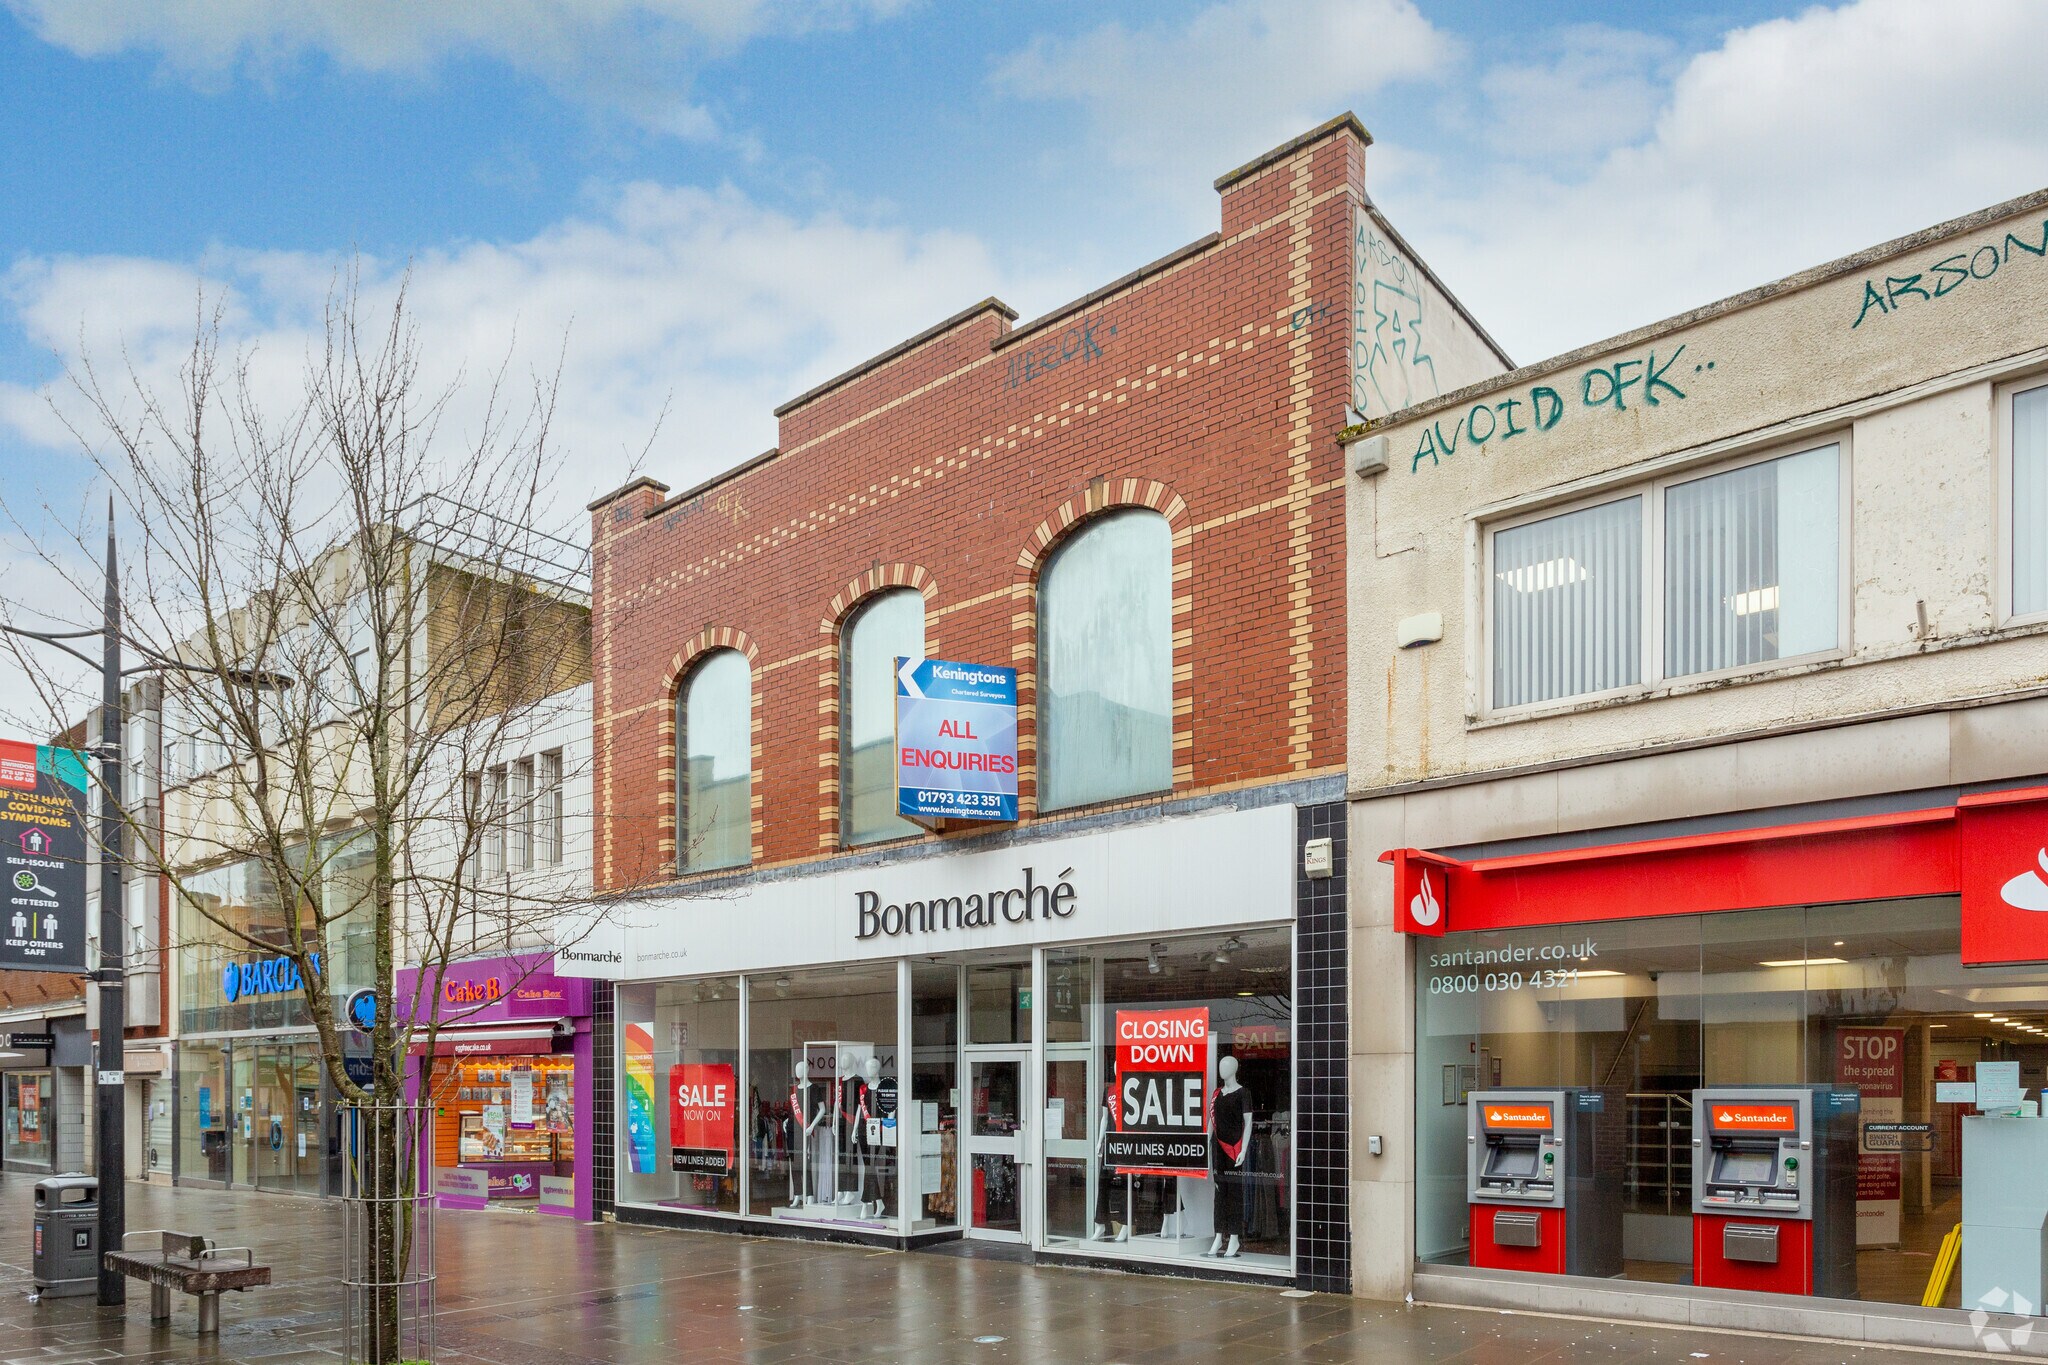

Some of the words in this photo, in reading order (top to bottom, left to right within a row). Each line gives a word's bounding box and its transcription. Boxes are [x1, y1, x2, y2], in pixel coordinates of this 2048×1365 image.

[1852, 218, 2048, 329] ARSON
[1411, 386, 1564, 474] AVOID
[933, 665, 1006, 685] Keningtons
[951, 688, 979, 697] Chartered
[980, 691, 1006, 700] Surveyors
[938, 719, 978, 740] ALL
[902, 747, 1015, 774] ENQUIRIES
[918, 791, 954, 803] 01793
[957, 794, 979, 806] 423
[981, 796, 1001, 806] 351
[918, 805, 1001, 817] www.keningtons.com
[0, 811, 71, 828] SYMPTOMS:
[7, 857, 65, 869] SELF-ISOLATE
[1307, 857, 1327, 865] KINGS
[29, 899, 59, 908] TESTED
[855, 867, 1078, 939] Bonmarché
[24, 948, 46, 956] SAFE
[29, 941, 64, 949] OTHERS
[1430, 937, 1598, 968] santander.co.uk
[561, 948, 622, 963] Bonmarché
[637, 948, 688, 962] bonmarche.co.uk
[1430, 975, 1479, 994] 0800
[1485, 972, 1522, 991] 030
[1529, 968, 1579, 989] 4321
[445, 979, 486, 1002] Cake
[517, 989, 541, 998] Cake
[543, 989, 561, 998] Box
[1120, 1019, 1205, 1040] CLOSING
[455, 1043, 491, 1051] eggfreecake.co.uk
[1234, 1030, 1287, 1050] SALE
[1131, 1044, 1194, 1063] DOWN
[1843, 1036, 1897, 1060] STOP
[1844, 1065, 1860, 1076] the
[1862, 1065, 1895, 1078] spread
[1856, 1081, 1893, 1090] oronavirus
[678, 1084, 726, 1107] SALE
[1123, 1077, 1202, 1126] SALE
[684, 1110, 704, 1121] NOW
[706, 1110, 720, 1121] ON
[1503, 1113, 1546, 1121] Santander
[1735, 1113, 1787, 1123] Santander
[1109, 1142, 1133, 1155] NEW
[1135, 1143, 1164, 1156] LINES
[1167, 1144, 1205, 1157] ADDED
[673, 1155, 688, 1164] NEW
[688, 1156, 704, 1166] LINES
[705, 1158, 726, 1167] ADDED
[1224, 1169, 1285, 1179] www.bonmarche.co.uk
[1856, 1210, 1885, 1218] Santander
